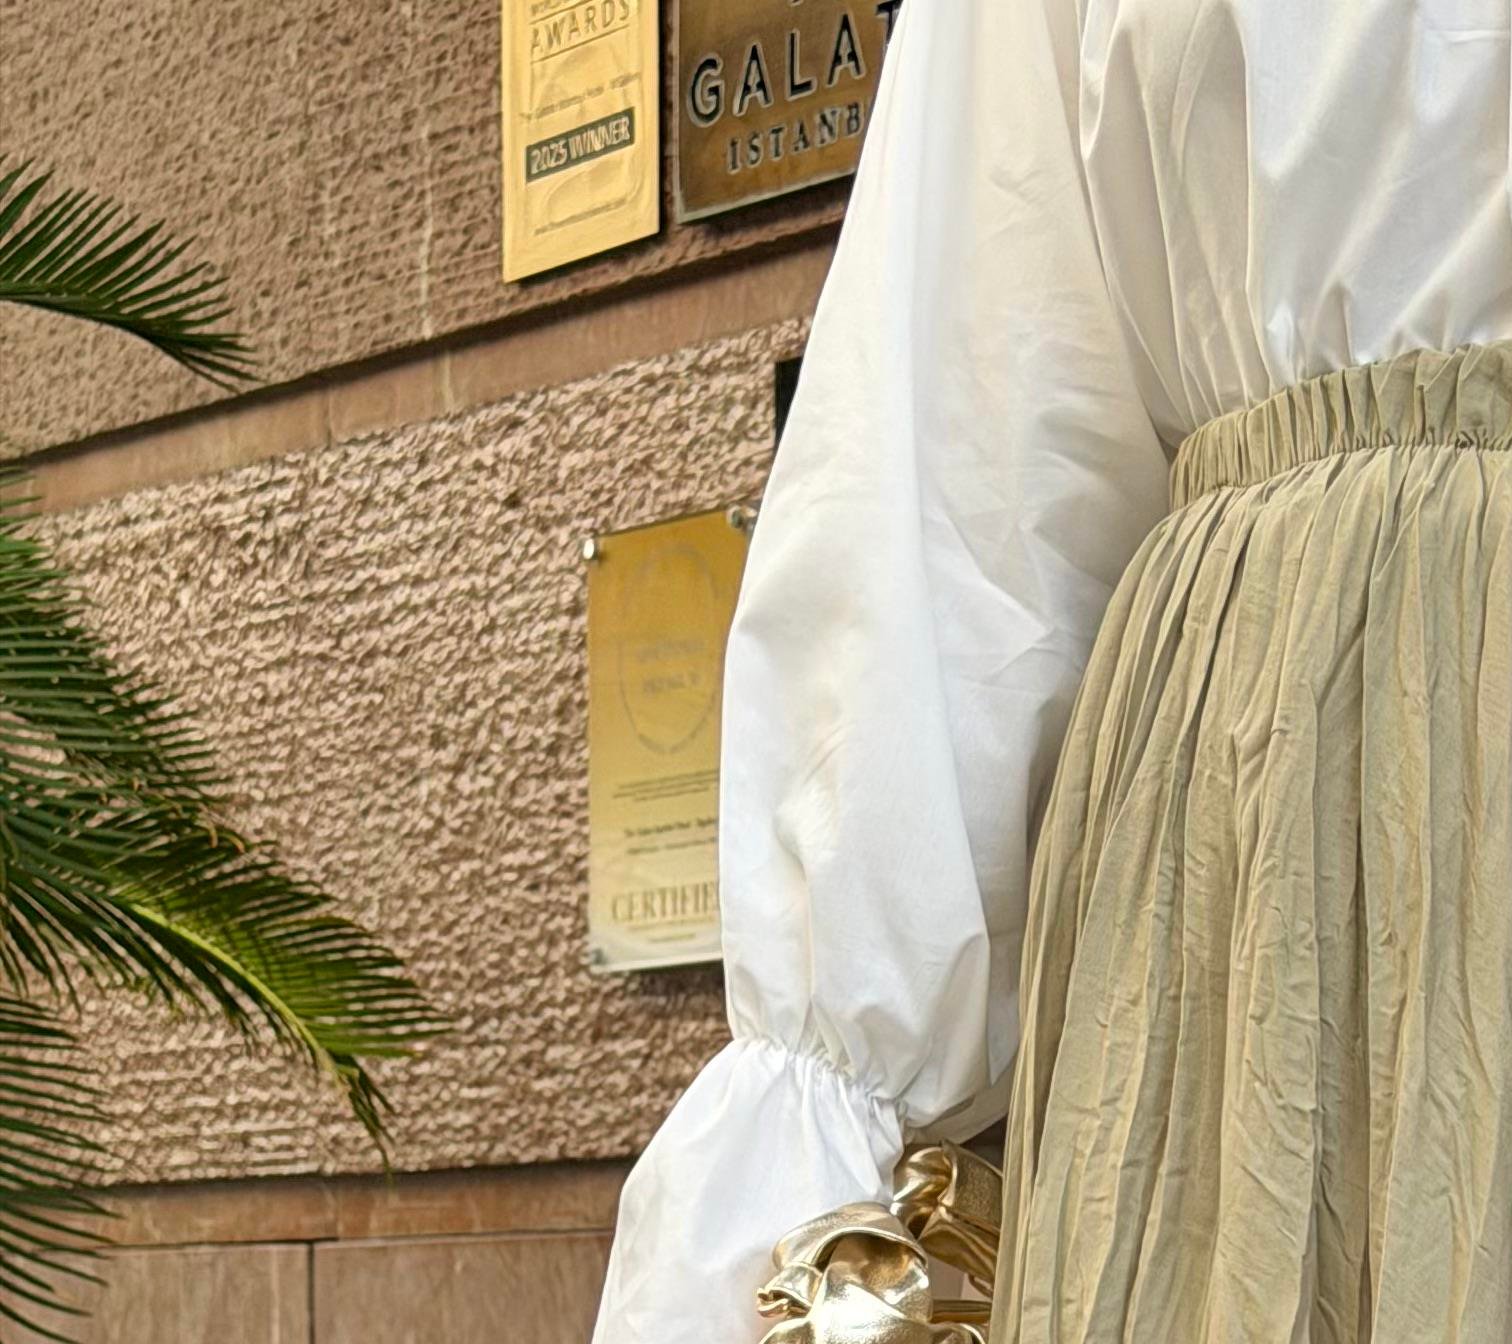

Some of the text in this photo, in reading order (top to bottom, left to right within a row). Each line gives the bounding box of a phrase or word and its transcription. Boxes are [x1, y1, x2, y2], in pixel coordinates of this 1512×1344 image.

[529, 0, 632, 55] AWARDS
[530, 115, 632, 176] 2025 WINNER
[611, 880, 719, 922] CERTIFIE
